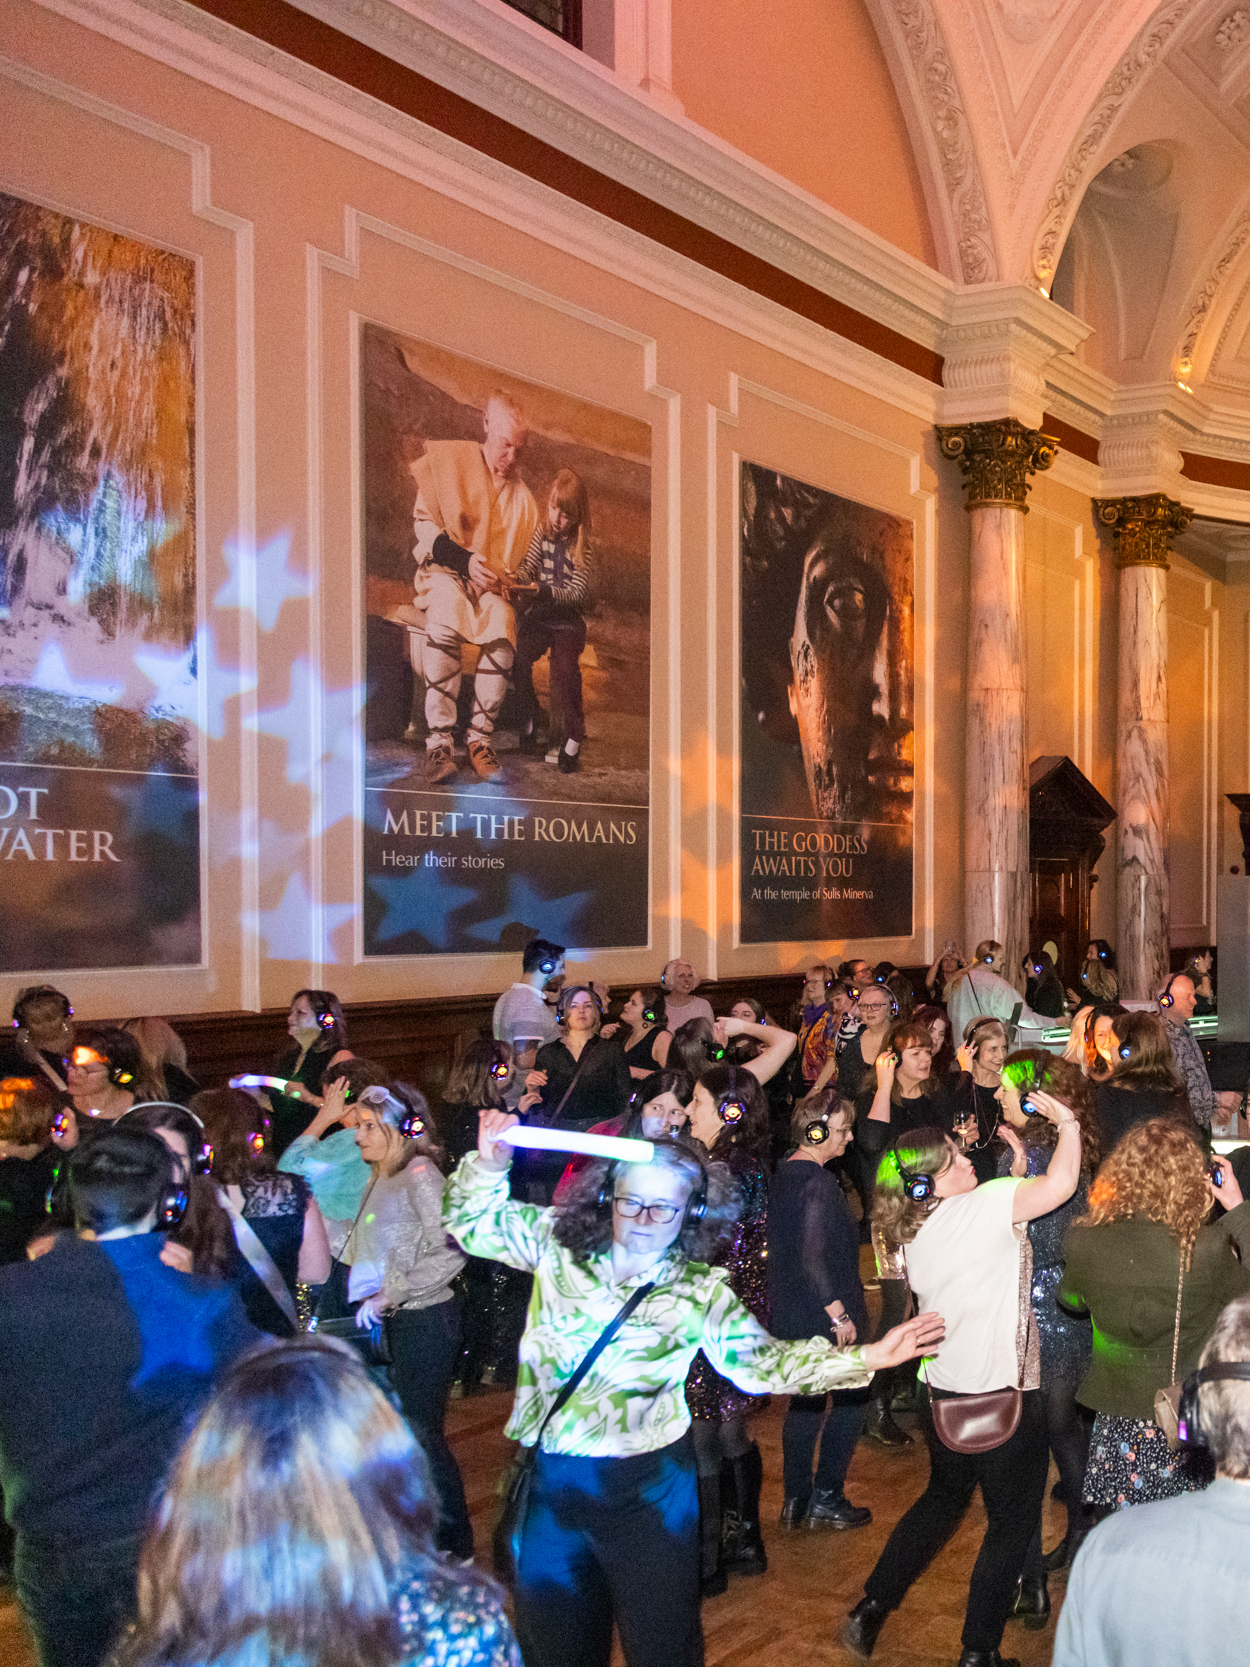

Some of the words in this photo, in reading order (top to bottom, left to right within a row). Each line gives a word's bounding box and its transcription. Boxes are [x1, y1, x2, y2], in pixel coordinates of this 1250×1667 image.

[382, 808, 463, 838] MEET
[470, 813, 525, 840] THE
[533, 817, 637, 845] ROMANS
[752, 829, 789, 851] THE
[793, 832, 868, 855] GODDESS
[382, 850, 419, 867] Hear
[424, 850, 457, 868] their
[461, 853, 505, 869] stories
[751, 855, 816, 877] AWAITS
[818, 857, 853, 878] YOU
[751, 887, 762, 900] At
[764, 887, 778, 900] the
[781, 888, 810, 903] temple
[812, 887, 821, 900] of
[823, 887, 841, 900] Sulis
[842, 888, 874, 900] Minerva
